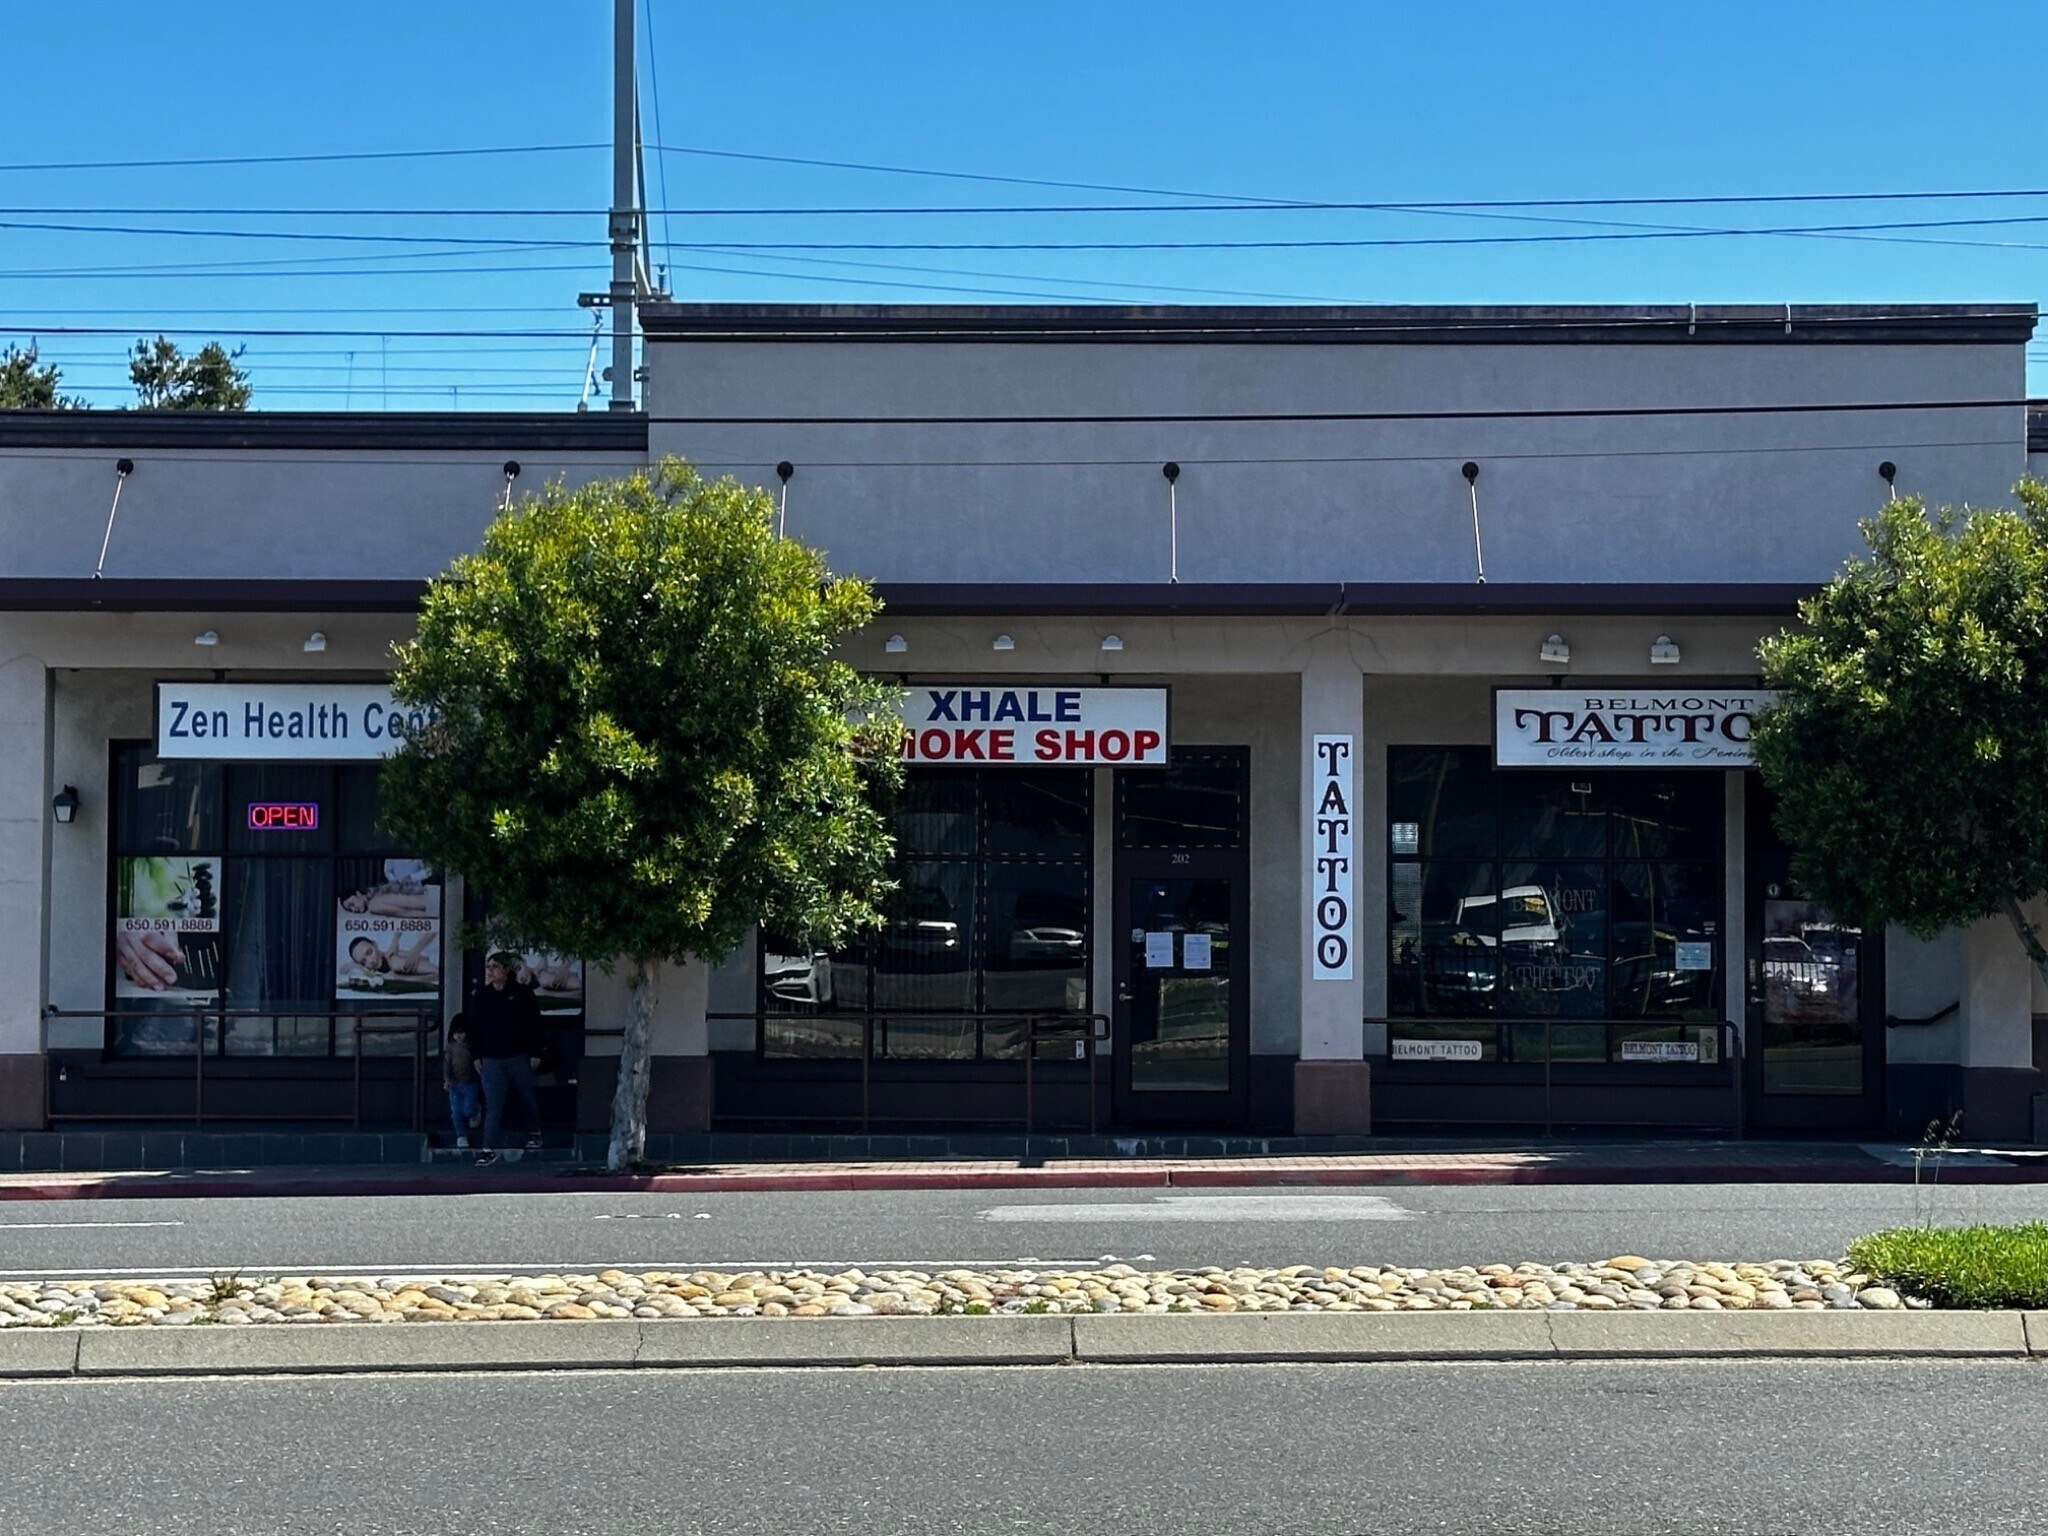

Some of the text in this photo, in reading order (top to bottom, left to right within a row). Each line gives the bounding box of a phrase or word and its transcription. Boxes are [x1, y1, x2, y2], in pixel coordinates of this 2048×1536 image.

[926, 690, 1082, 722] XHALE
[1584, 698, 1755, 711] BELMONT
[169, 701, 440, 740] Zen Health Cent
[1515, 708, 1760, 748] TATTO
[1033, 728, 1161, 761] SHOP
[1598, 747, 1634, 760] shop
[1640, 748, 1657, 758] in
[1661, 748, 1684, 758] the
[252, 807, 315, 827] OPEN
[1171, 853, 1190, 864] 202
[1317, 742, 1349, 969] TATTOO
[126, 919, 213, 931] 650.591.8888
[345, 920, 432, 932] 650.591.8888
[1441, 1044, 1478, 1056] TATTOO
